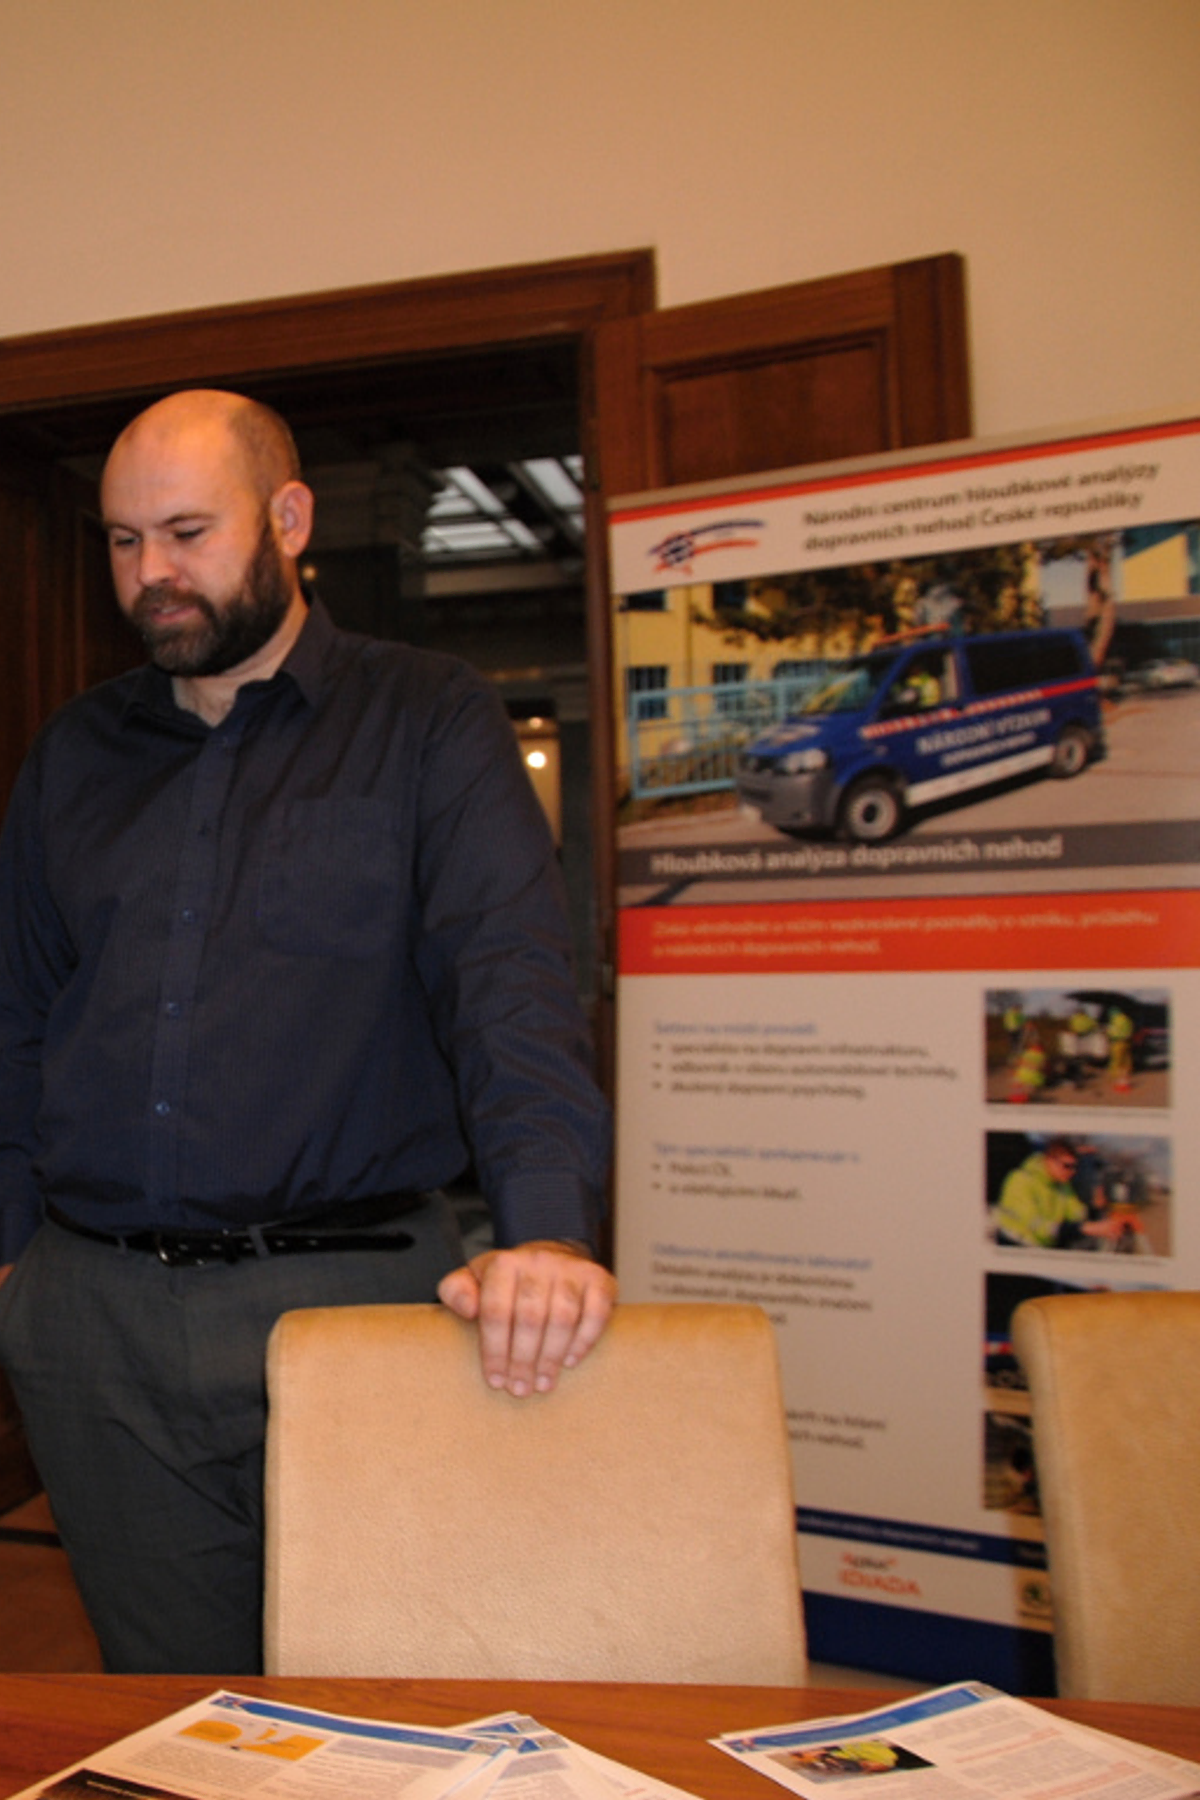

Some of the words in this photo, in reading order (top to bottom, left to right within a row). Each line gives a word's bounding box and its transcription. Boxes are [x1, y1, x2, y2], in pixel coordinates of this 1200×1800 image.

[882, 493, 962, 516] centrum
[1077, 461, 1162, 487] analýzy
[913, 513, 978, 536] nehod
[980, 503, 1036, 528] České
[1042, 490, 1144, 519] republiky
[650, 844, 761, 877] Hloubková
[764, 842, 848, 873] analýza
[850, 838, 980, 870] dopravních
[983, 834, 1063, 861] nehod
